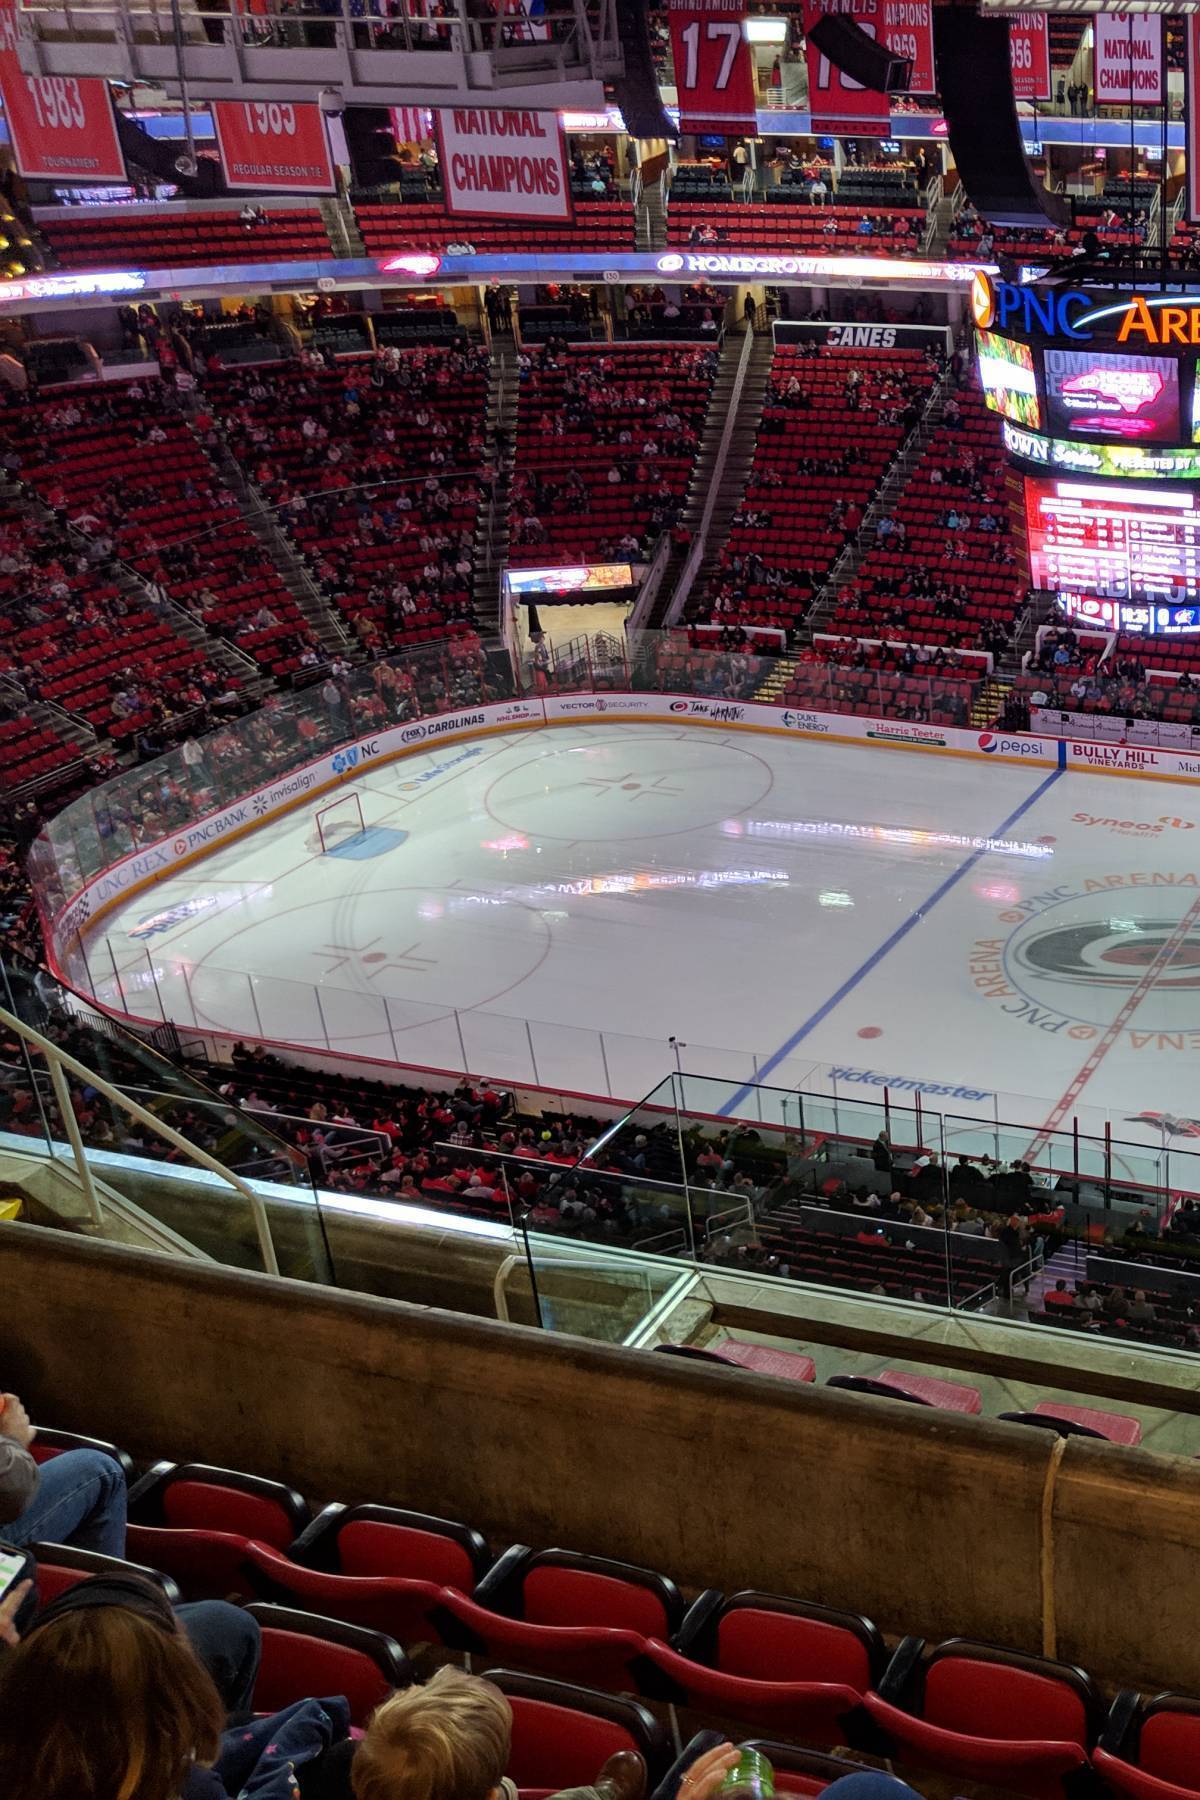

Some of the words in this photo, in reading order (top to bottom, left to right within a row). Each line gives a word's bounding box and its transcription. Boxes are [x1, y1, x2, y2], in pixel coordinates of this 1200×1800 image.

[884, 3, 928, 26] AMPIONS
[682, 22, 743, 90] 17
[1104, 40, 1153, 60] NATIONAL
[1100, 69, 1159, 90] CHAMPIONS
[27, 77, 85, 128] 1983
[453, 111, 546, 137] NATIONAL
[43, 157, 100, 169] TOURNAMENT
[234, 164, 273, 176] REGULAR
[274, 166, 307, 177] SEASON
[452, 153, 560, 196] CHAMPIONS
[607, 272, 618, 280] 130
[997, 281, 1092, 340] PNC
[826, 327, 896, 347] CANES
[560, 702, 594, 710] VECTOR
[608, 701, 648, 710] SECURITY
[406, 728, 421, 737] FOX
[427, 714, 485, 735] CAROLINAS
[797, 713, 818, 723] DUKE
[797, 721, 829, 732] ENERGY
[876, 723, 909, 735] Harris
[912, 727, 945, 739] Teeter
[361, 741, 380, 759] NC
[1001, 739, 1043, 755] pepsi
[1072, 744, 1121, 761] BULLY
[1126, 750, 1159, 765] HILL
[1088, 757, 1145, 770] VINEYARDS
[1072, 813, 1164, 832] Syneos
[96, 866, 129, 900] UNC
[132, 848, 168, 879] REX
[269, 773, 315, 802] invisalign
[1012, 885, 1078, 912] PNC
[1084, 873, 1199, 892] ARENA
[970, 939, 1016, 998] ARENA
[1001, 999, 1069, 1033] PNC
[828, 1067, 994, 1101] ticketmaster
